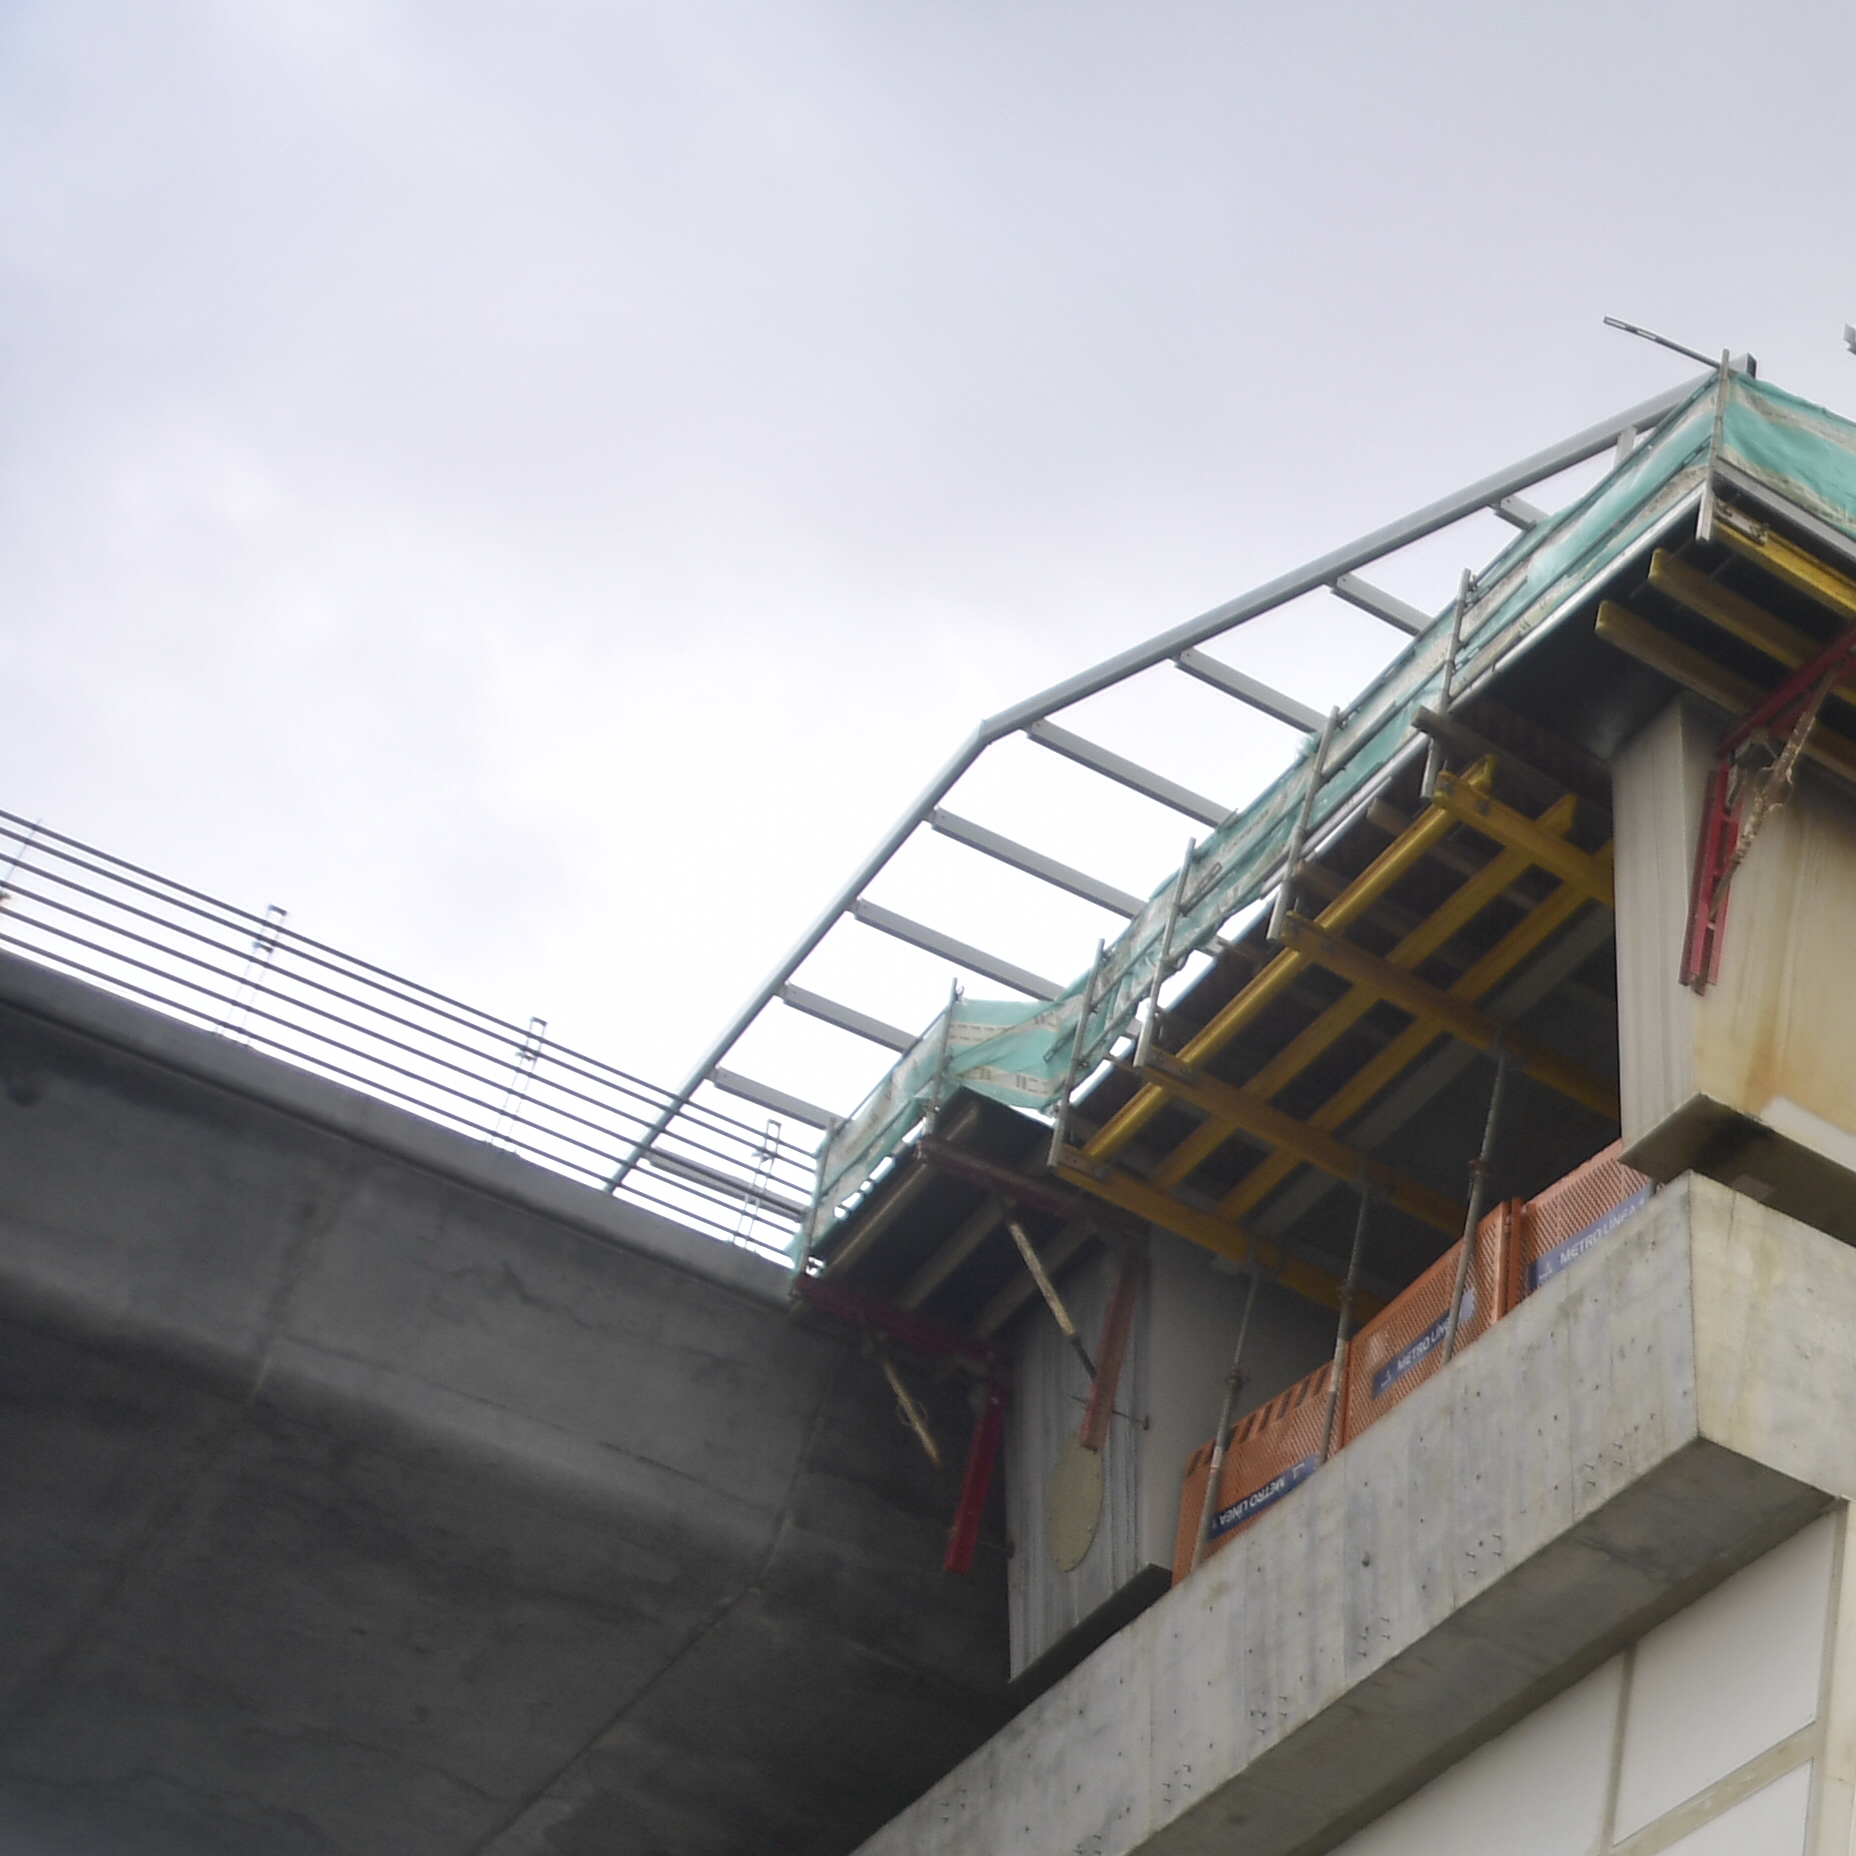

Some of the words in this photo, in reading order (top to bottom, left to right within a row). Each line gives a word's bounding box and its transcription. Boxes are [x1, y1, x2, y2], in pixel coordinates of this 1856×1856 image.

[1560, 1231, 1601, 1264] METRO
[1397, 1336, 1430, 1371] METRO
[1250, 1476, 1285, 1507] METRO
